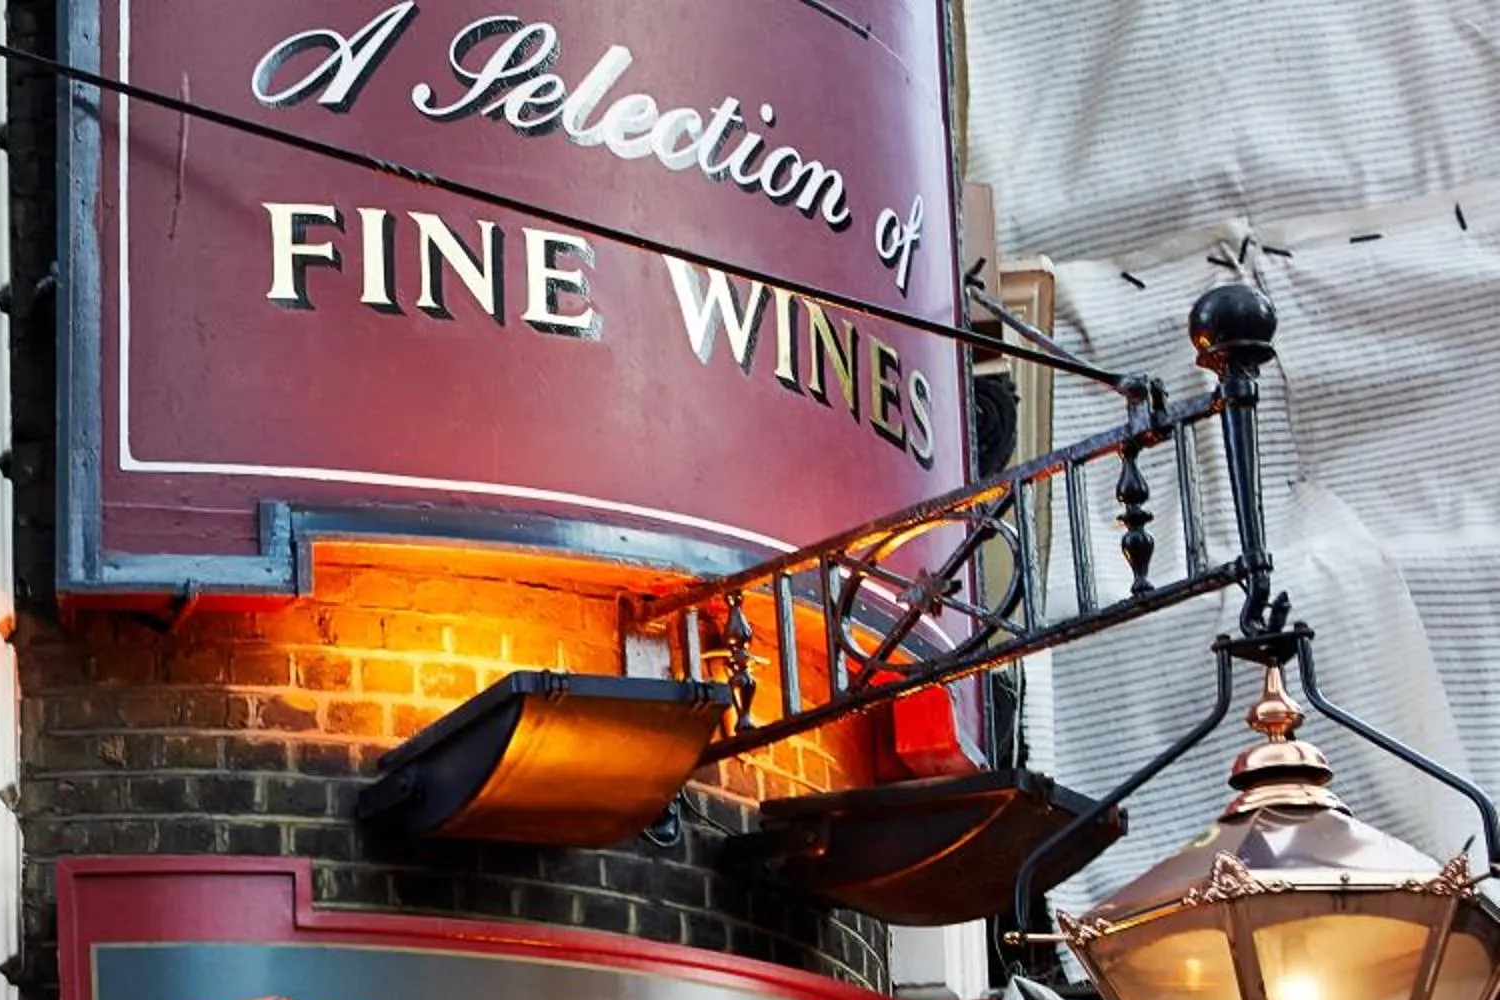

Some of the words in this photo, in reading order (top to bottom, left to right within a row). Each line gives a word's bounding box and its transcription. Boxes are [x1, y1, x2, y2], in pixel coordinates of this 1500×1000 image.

[252, 1, 418, 106] A
[411, 15, 849, 229] Selection
[875, 194, 923, 289] of
[262, 202, 597, 333] FINE
[662, 254, 931, 462] WINES
